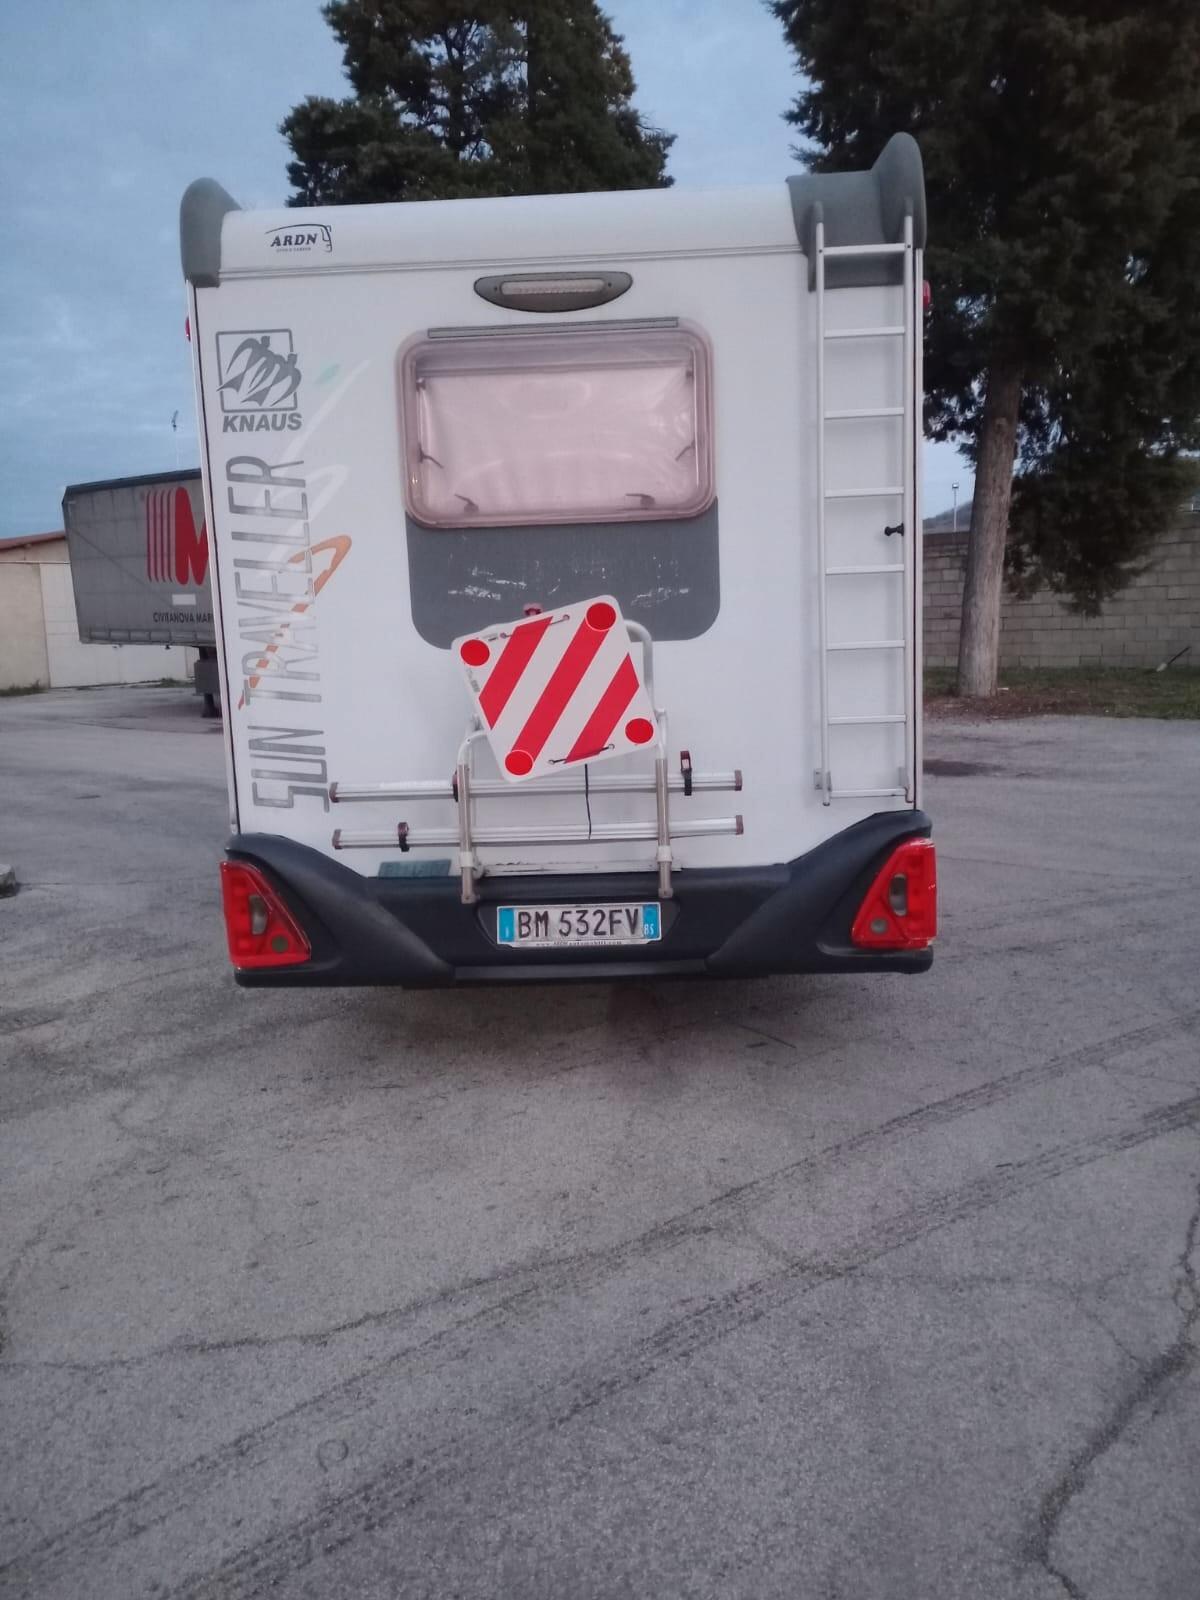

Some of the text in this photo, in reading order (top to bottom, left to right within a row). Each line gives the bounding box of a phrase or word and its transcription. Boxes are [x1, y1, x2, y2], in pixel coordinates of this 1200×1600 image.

[223, 413, 302, 432] KNAUS
[226, 455, 329, 813] SUN TRAVELLER
[518, 908, 638, 938] BM 532FV
